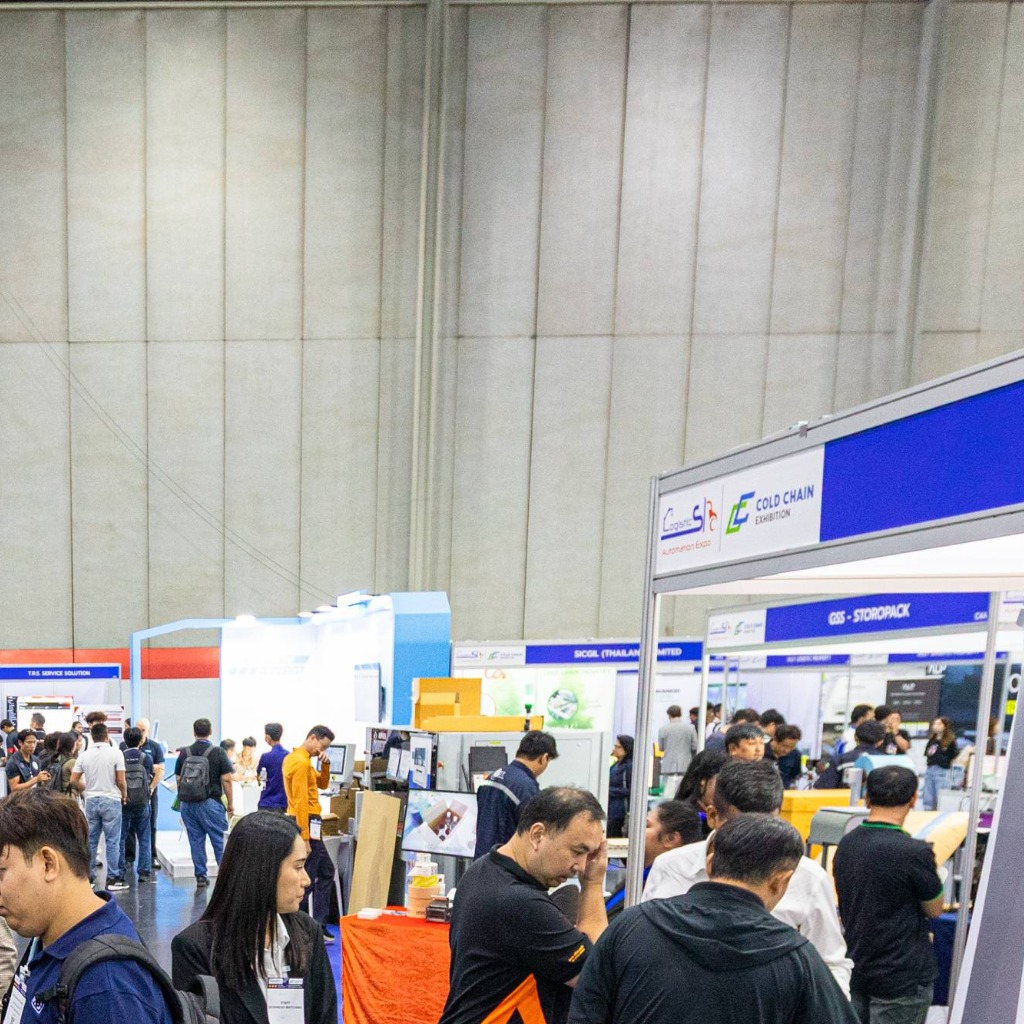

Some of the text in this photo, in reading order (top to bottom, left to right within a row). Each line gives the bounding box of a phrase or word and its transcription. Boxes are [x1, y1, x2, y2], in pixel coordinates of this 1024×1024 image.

[756, 485, 815, 511] COLD CHAIN
[755, 508, 791, 525] EXHIBITION
[661, 539, 712, 556] Automation Expo
[828, 610, 846, 625] GSS
[853, 603, 911, 623] STOROPACK
[574, 650, 599, 658] SICGIL
[601, 648, 640, 659] (THAILAN
